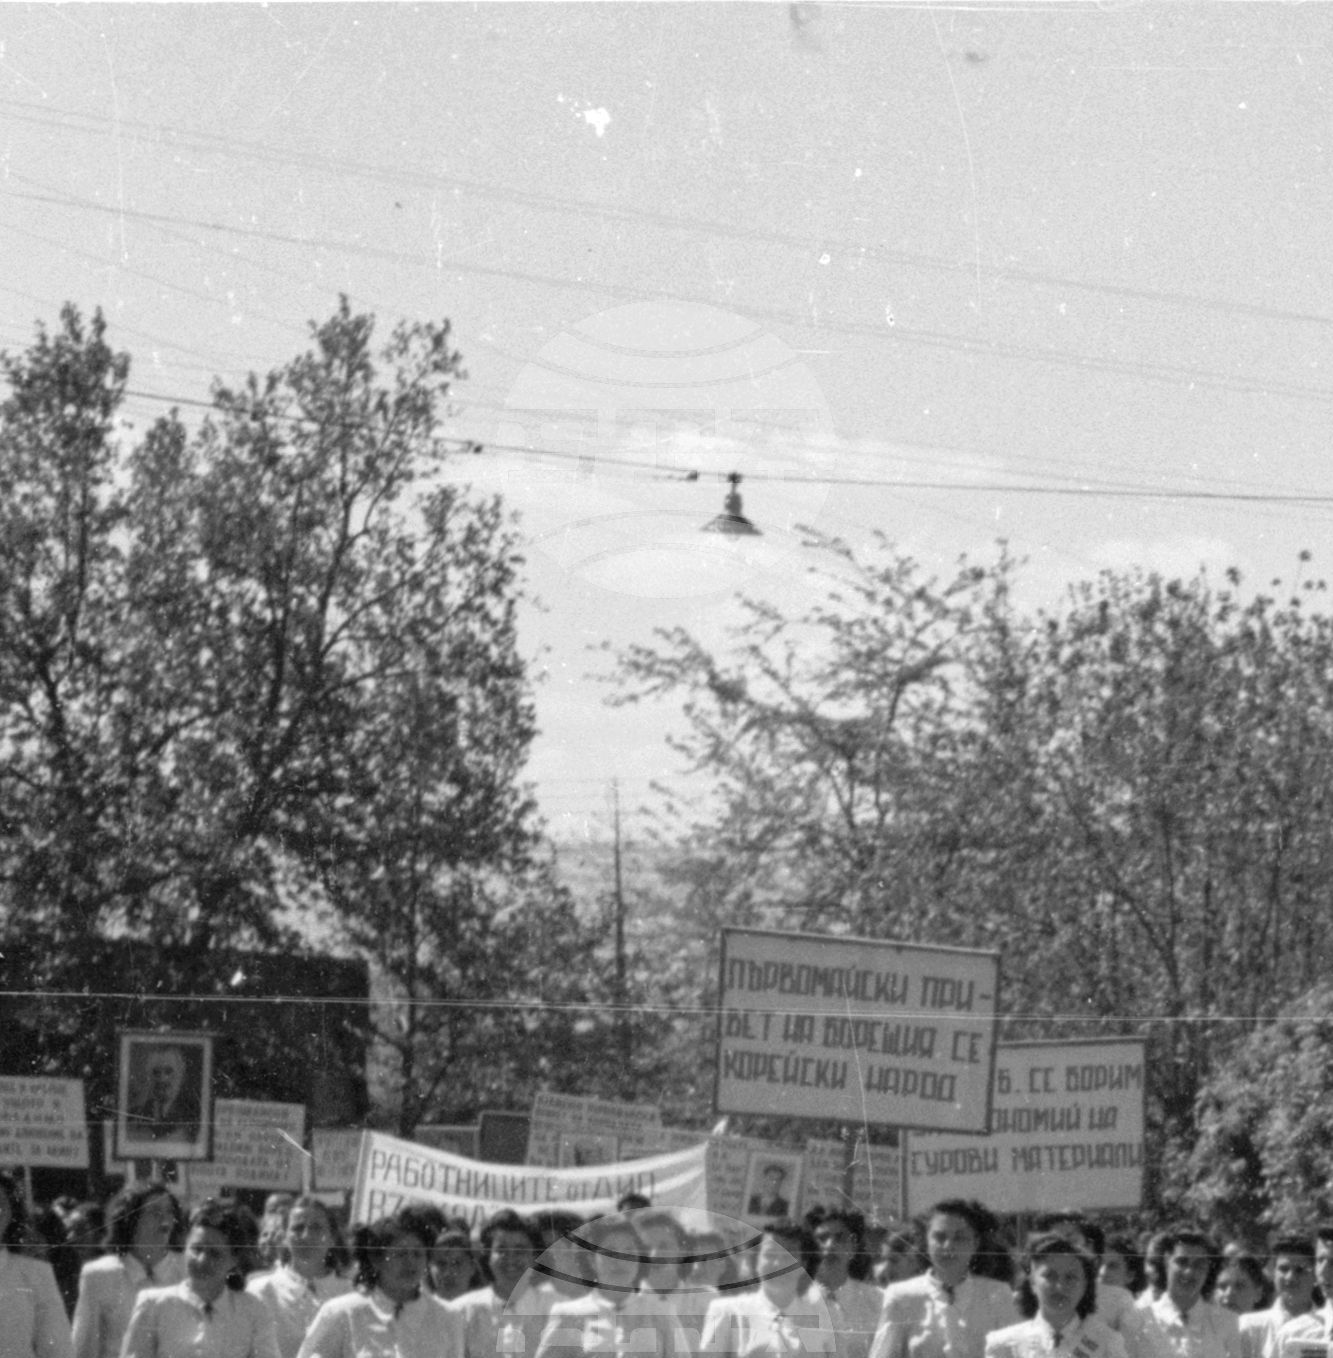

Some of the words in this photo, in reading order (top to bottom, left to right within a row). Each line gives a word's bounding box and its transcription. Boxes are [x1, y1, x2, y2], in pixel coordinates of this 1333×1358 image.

[727, 957, 909, 1005] ПЪРВОМАЙСКИ
[782, 1014, 815, 1045] НА
[823, 1016, 937, 1059] БОРЕЩИЯ
[951, 1029, 984, 1064] СЕ
[723, 1049, 848, 1090] КОРЕЙСКИ
[866, 1065, 957, 1103] НАРОД
[1029, 1066, 1057, 1093] СЕ
[1065, 1064, 1143, 1092] БОРИМ
[991, 1102, 1081, 1133] ОНОМИЙ
[1088, 1106, 1118, 1131] НА
[371, 1149, 554, 1202] РАБОТНИЦИТЕ
[567, 1179, 587, 1201] от
[910, 1147, 999, 1176] СУРОВИ
[1011, 1142, 1143, 1173] МАТЕРИАЛИ
